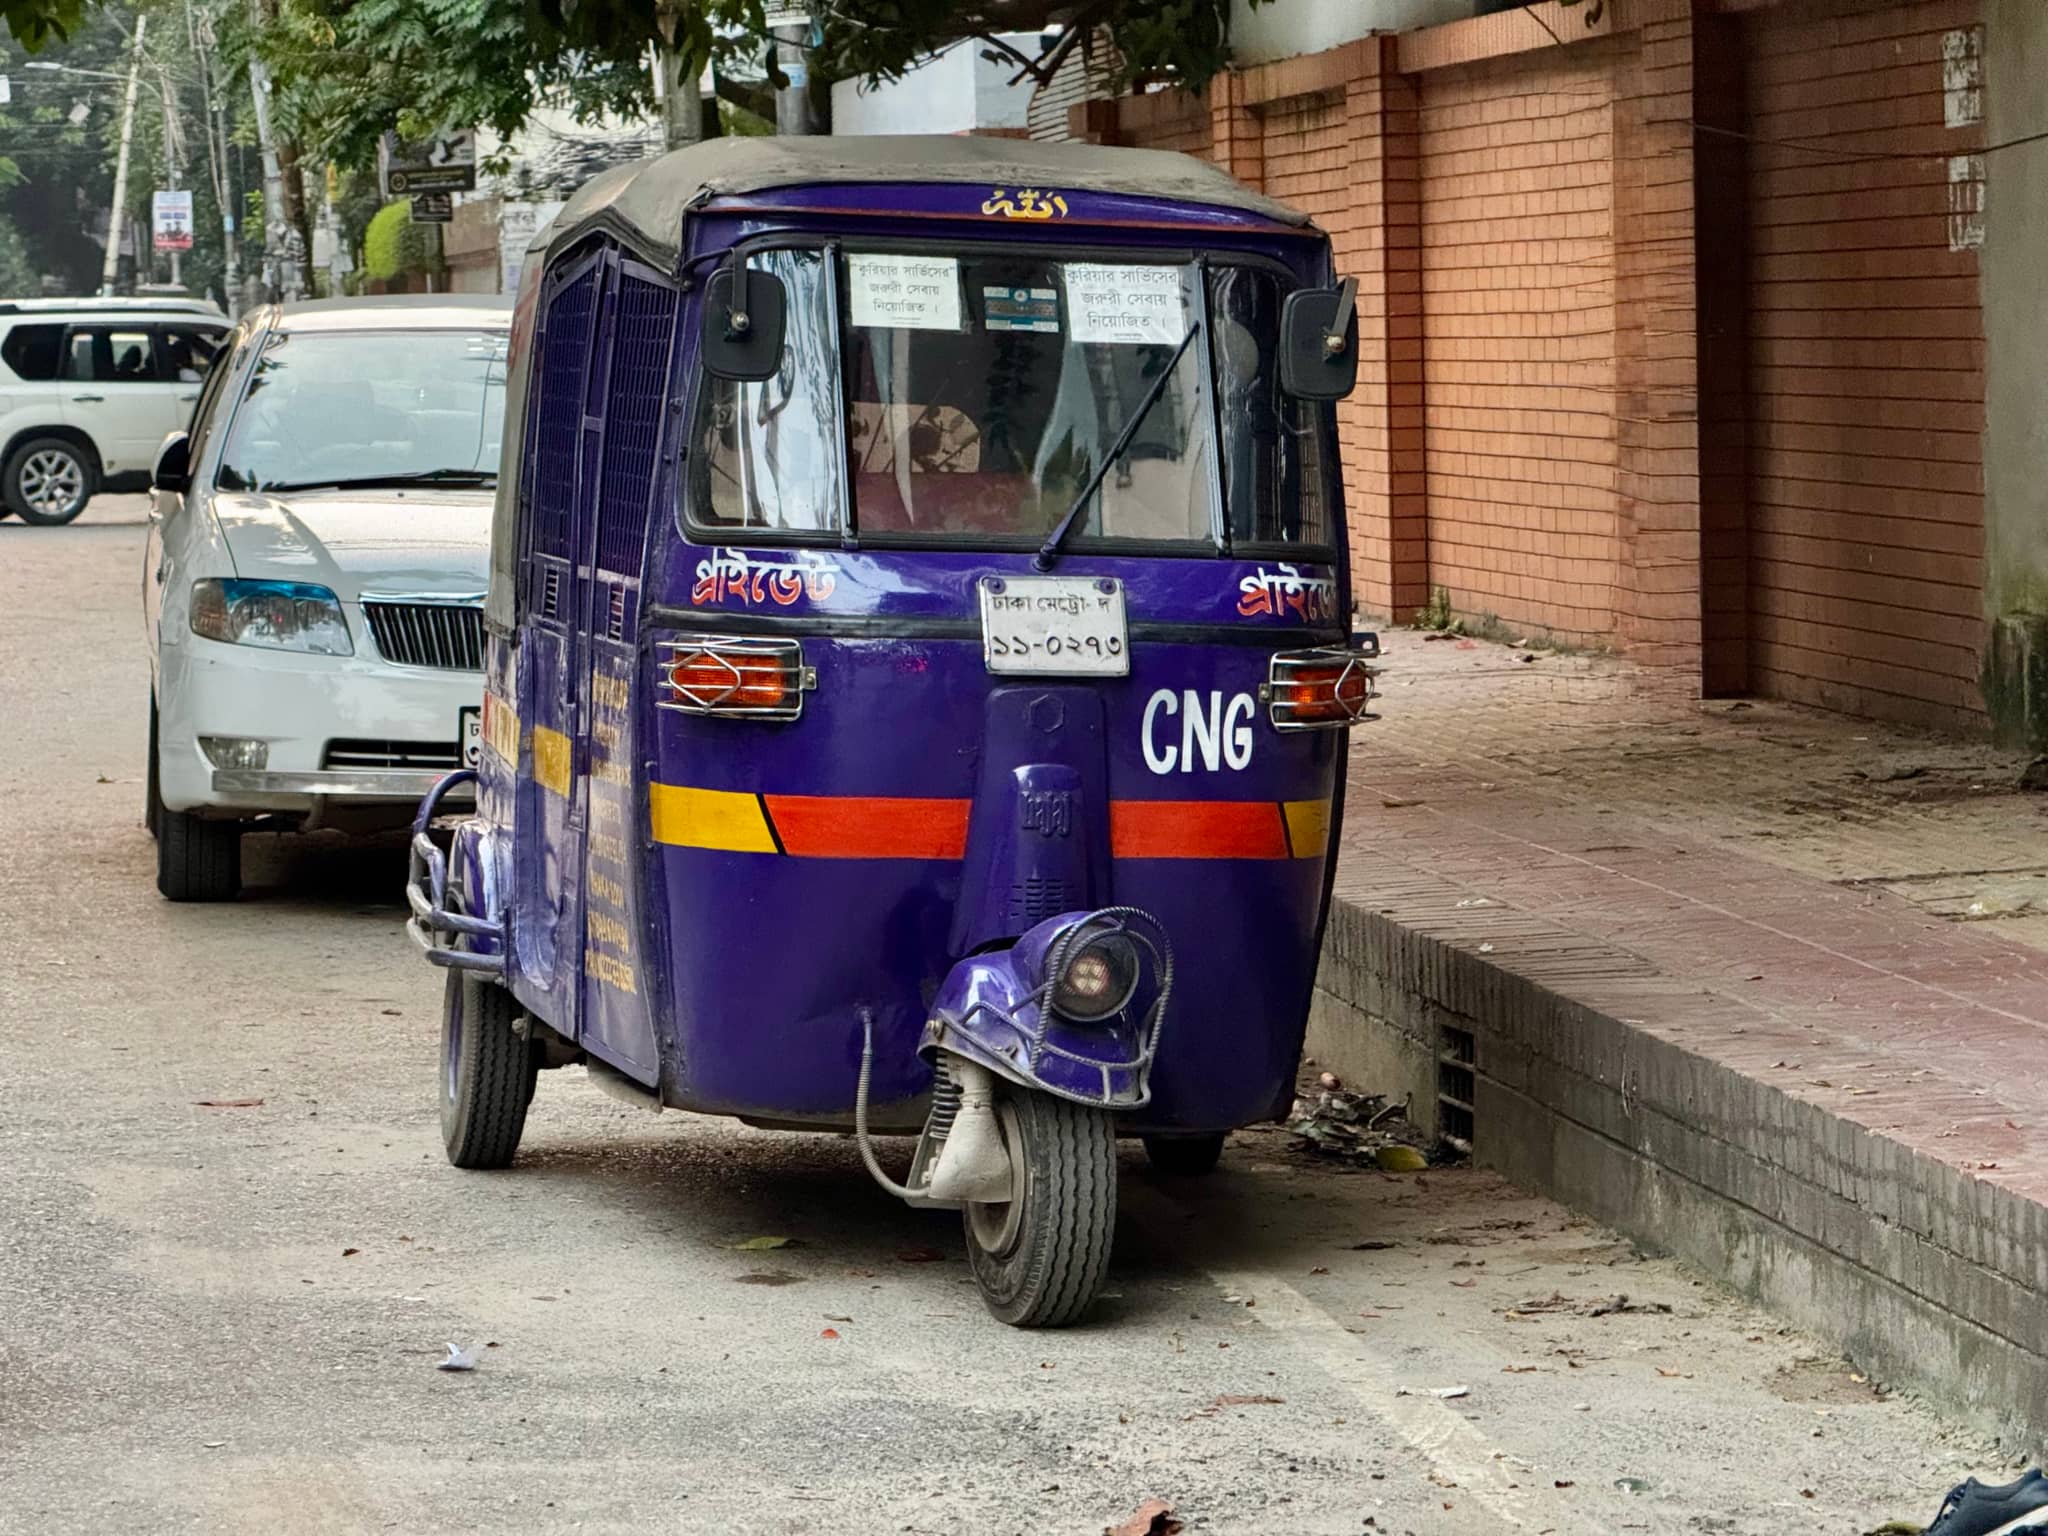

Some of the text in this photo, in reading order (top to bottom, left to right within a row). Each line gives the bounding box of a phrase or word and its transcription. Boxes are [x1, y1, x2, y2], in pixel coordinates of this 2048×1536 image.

[691, 546, 841, 606] প্রাইভেট
[992, 595, 1031, 612] ঢাকা
[1236, 562, 1337, 623] প্রাইভে
[992, 635, 1122, 656] ১১-০২৭৩
[1141, 688, 1256, 775] CNG
